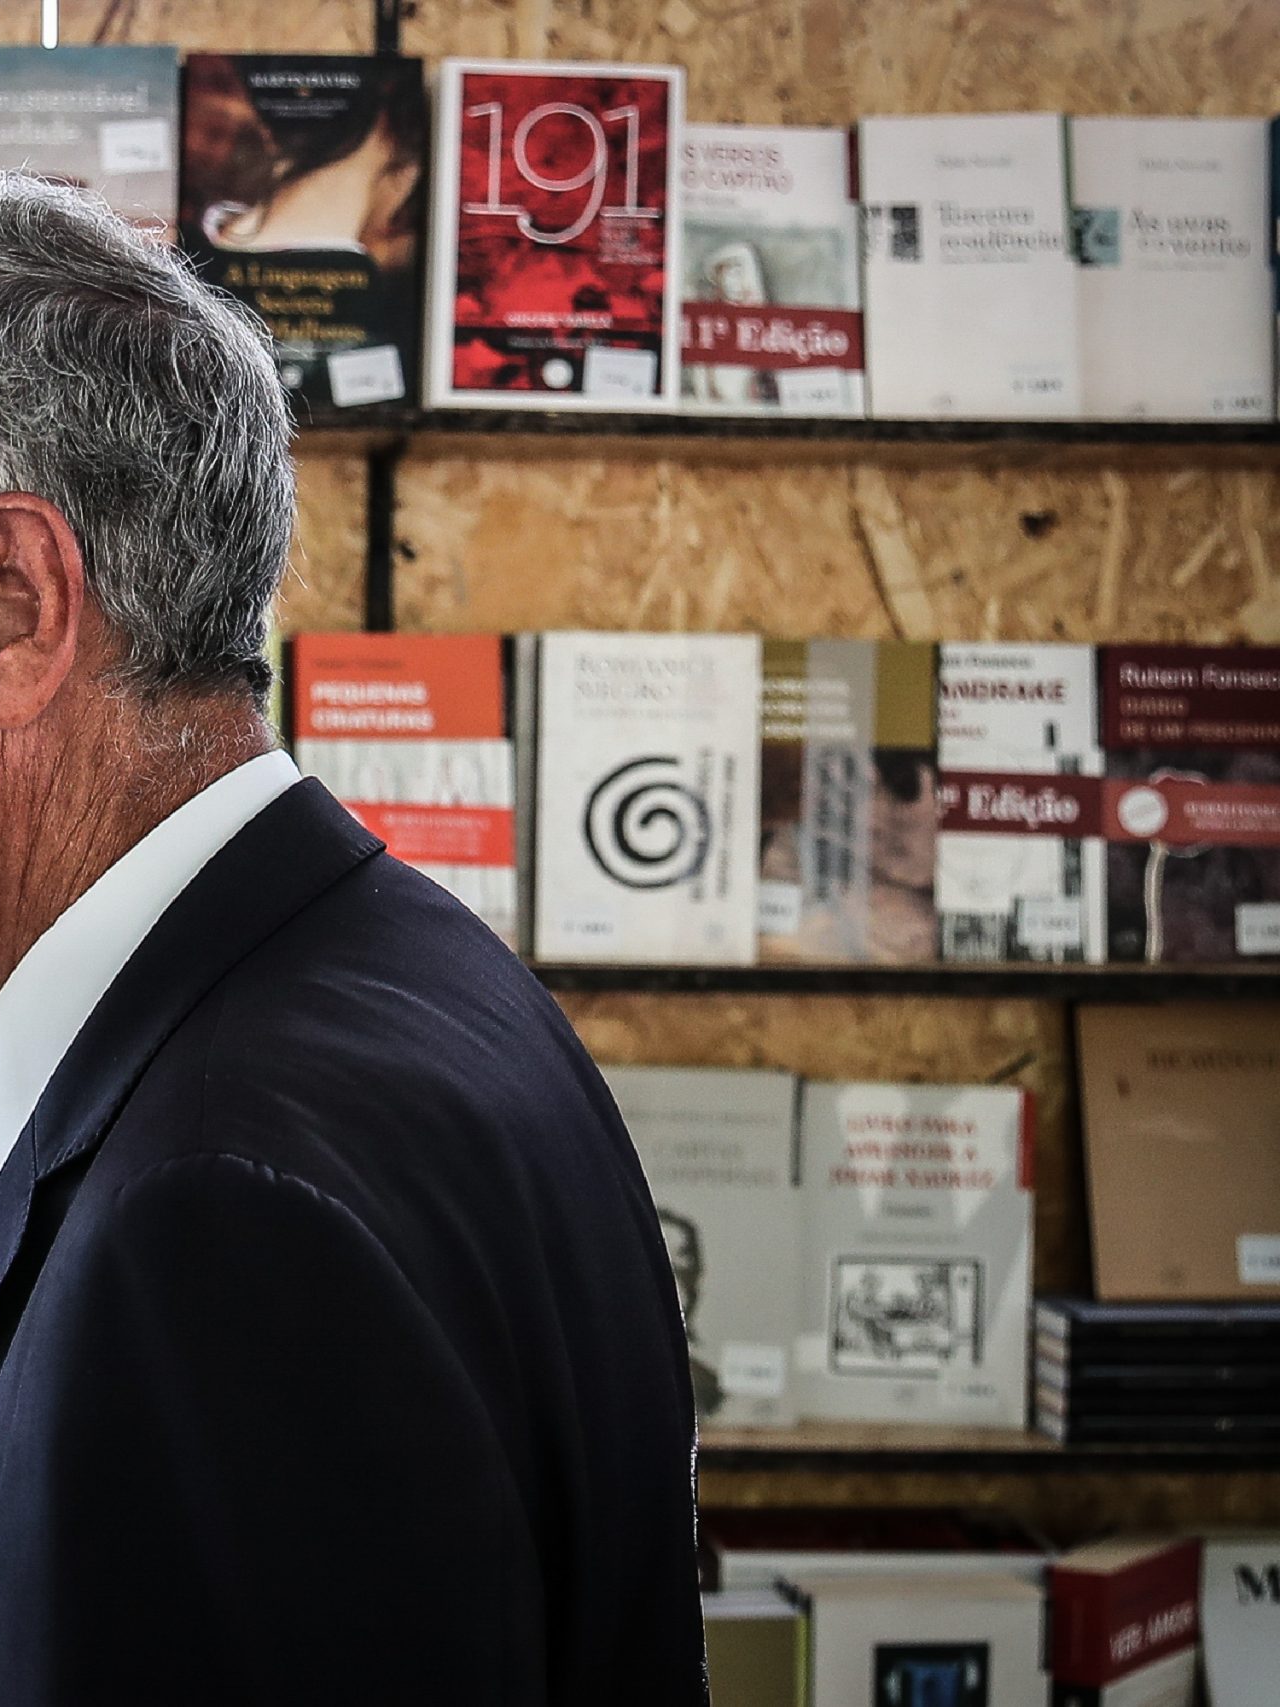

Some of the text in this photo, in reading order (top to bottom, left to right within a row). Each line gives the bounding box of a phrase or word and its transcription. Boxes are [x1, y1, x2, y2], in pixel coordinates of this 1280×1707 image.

[461, 102, 660, 244] 191
[736, 316, 851, 363] Edição
[939, 680, 1068, 703] ANDRAKE
[967, 785, 1081, 829] Edição
